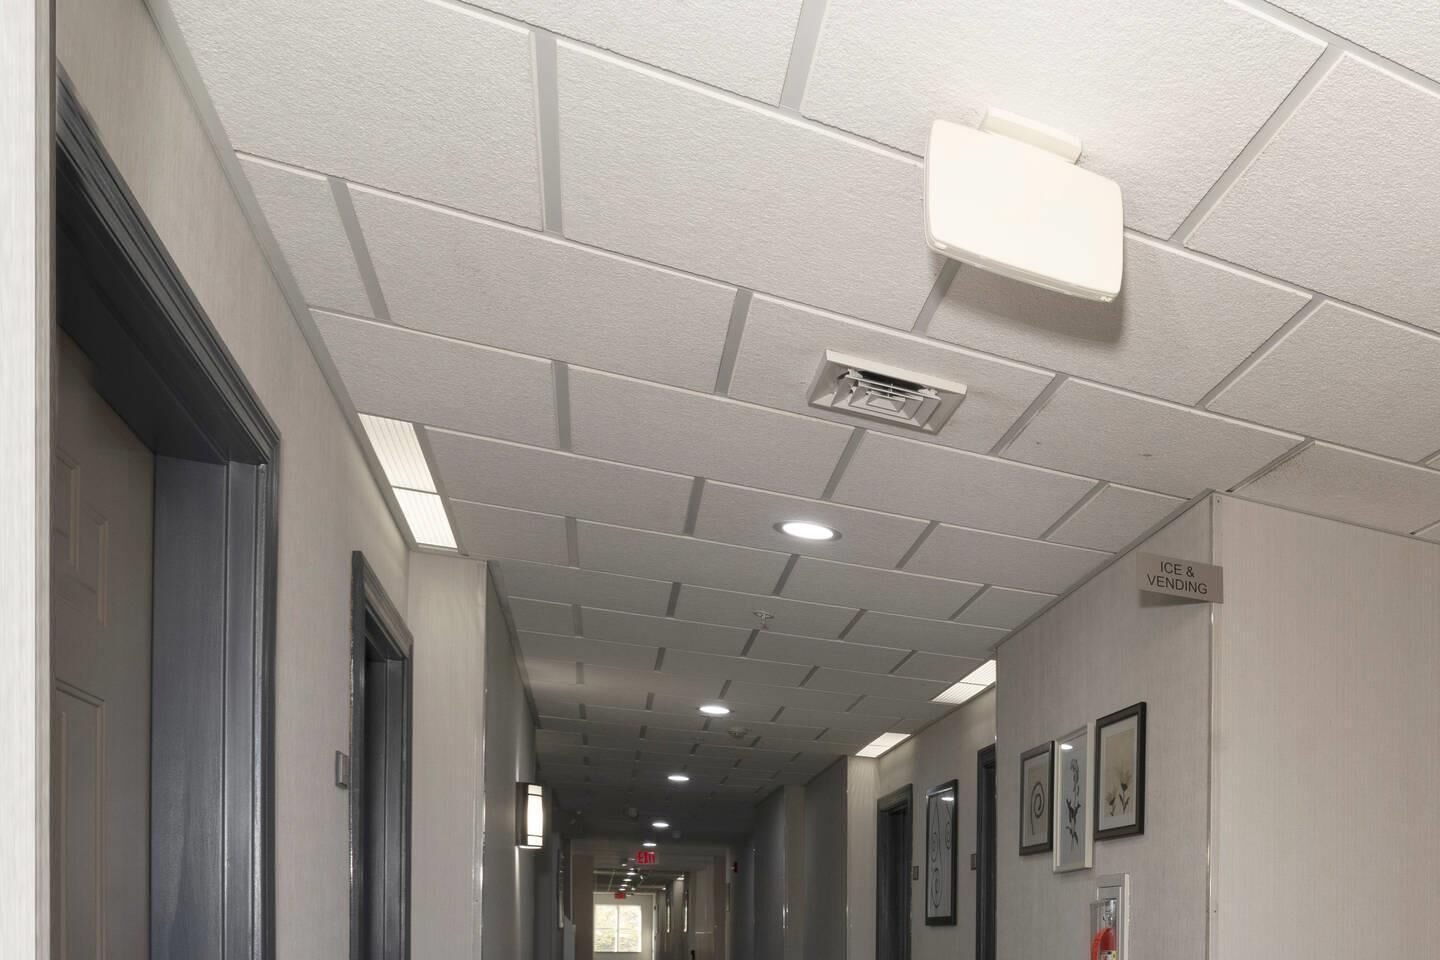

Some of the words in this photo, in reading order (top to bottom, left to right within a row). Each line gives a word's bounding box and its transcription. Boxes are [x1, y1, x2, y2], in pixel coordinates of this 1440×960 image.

[1160, 561, 1183, 576] ICE
[1186, 566, 1195, 578] &
[1147, 573, 1208, 594] VENDING
